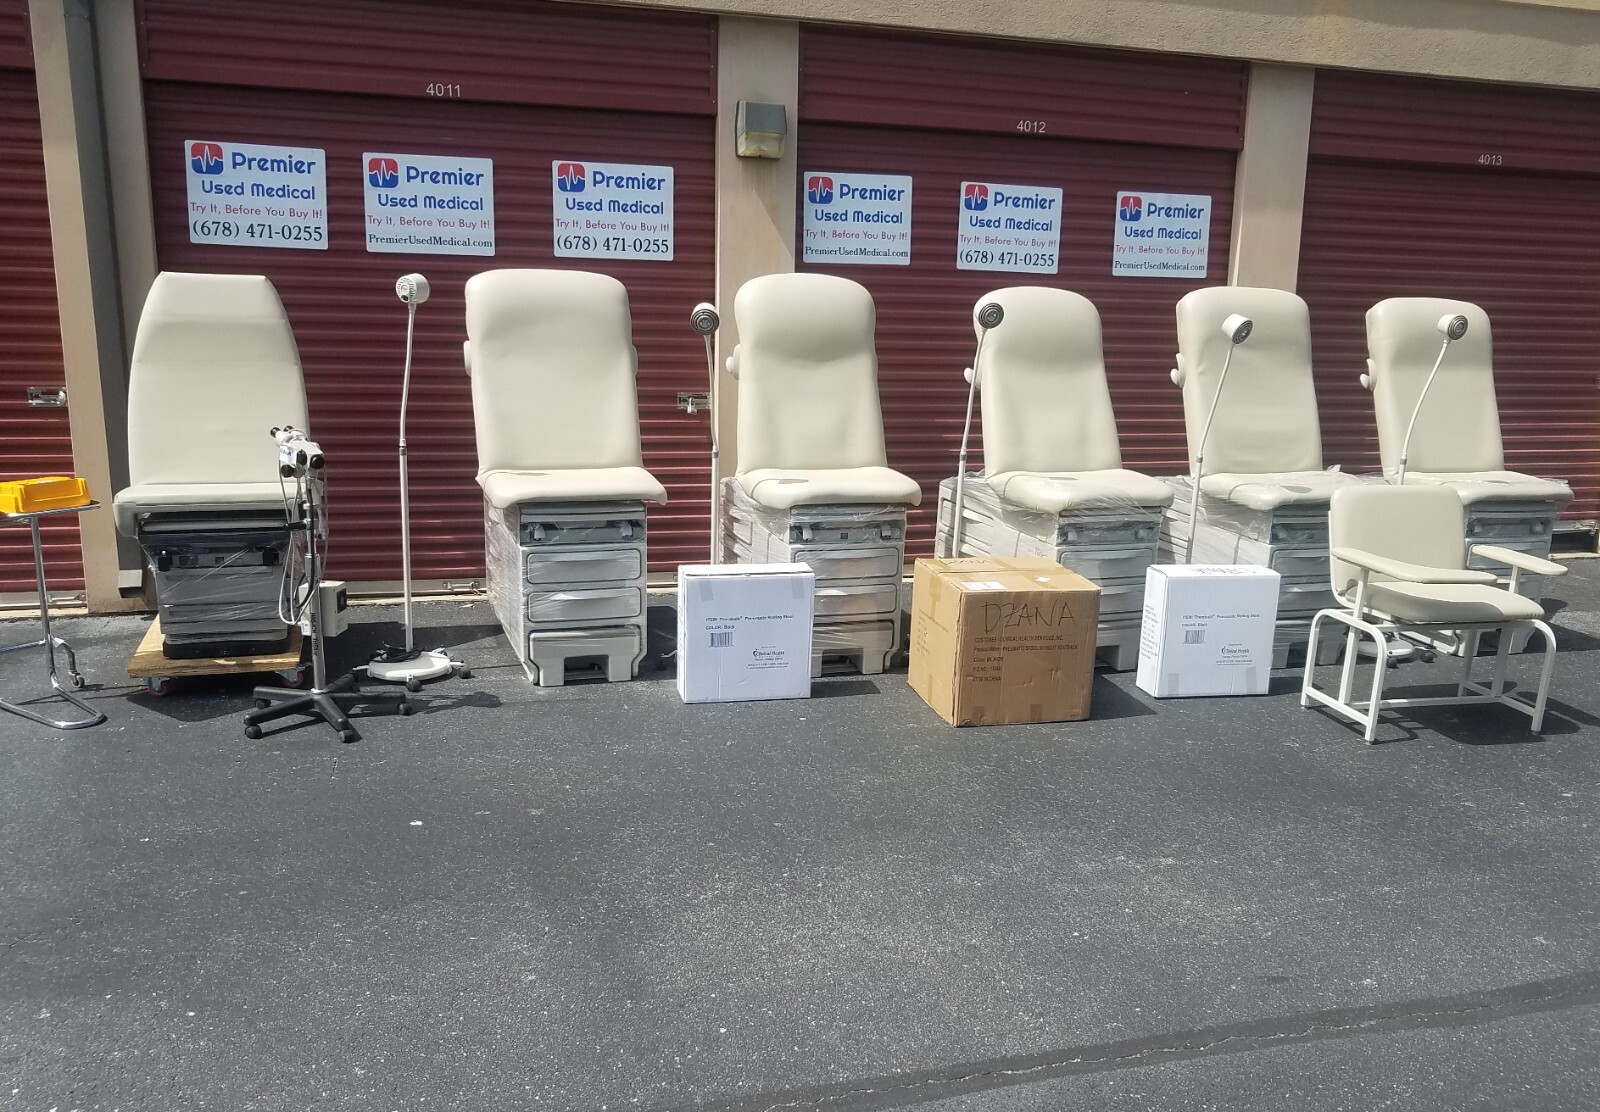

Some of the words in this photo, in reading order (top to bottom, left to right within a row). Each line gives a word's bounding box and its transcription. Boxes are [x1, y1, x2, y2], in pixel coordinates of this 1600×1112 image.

[426, 83, 460, 98] 4011
[1017, 120, 1046, 133] 4012
[231, 152, 316, 174] Premier
[1478, 154, 1503, 166] 4013
[406, 165, 484, 186] Premier
[592, 170, 666, 190] Premier
[201, 180, 245, 196] Used
[251, 183, 316, 200] Medical
[839, 183, 905, 201] Premier
[377, 193, 418, 208] Used
[423, 195, 483, 211] Medical
[565, 197, 603, 211] Used
[608, 199, 664, 214] Medical
[993, 191, 1056, 210] Premier
[190, 202, 206, 215] Try
[225, 204, 261, 216] Before
[265, 207, 285, 217] You
[289, 208, 309, 220] Buy
[815, 208, 848, 221] Used
[852, 210, 903, 224] Medical
[1147, 202, 1205, 219] Premier
[193, 220, 240, 238] (678)
[246, 223, 322, 241] 471-0255
[367, 214, 382, 226] Try
[400, 216, 433, 226] Before
[436, 218, 455, 227] You
[459, 218, 477, 230] Buy
[555, 218, 569, 230] Try
[585, 220, 617, 230] Before
[620, 221, 637, 231] You
[640, 222, 657, 233] Buy
[969, 215, 1001, 228] Used
[1005, 217, 1053, 232] Medical
[368, 233, 493, 247] PremierUsedMedical.com
[805, 229, 818, 239] Try
[832, 229, 860, 239] Before
[863, 230, 879, 240] You
[881, 231, 896, 242] Buy
[960, 234, 972, 244] Try
[985, 235, 1011, 245] Before
[1014, 237, 1029, 246] You
[1031, 239, 1046, 249] Buy
[1124, 226, 1154, 238] Used
[1157, 227, 1202, 240] Medical
[557, 235, 597, 251] (678)
[603, 237, 669, 253] 471-0255
[805, 246, 909, 258] PremierUsedMedical.com
[1115, 244, 1126, 253] Try
[1138, 245, 1163, 254] Before
[1166, 246, 1180, 255] You
[1182, 247, 1196, 257] Buy
[959, 249, 994, 264] (678)
[998, 251, 1055, 267] 471-0255
[1114, 260, 1205, 271] PremierUsedMedical.com
[981, 599, 1077, 635] DZANA
